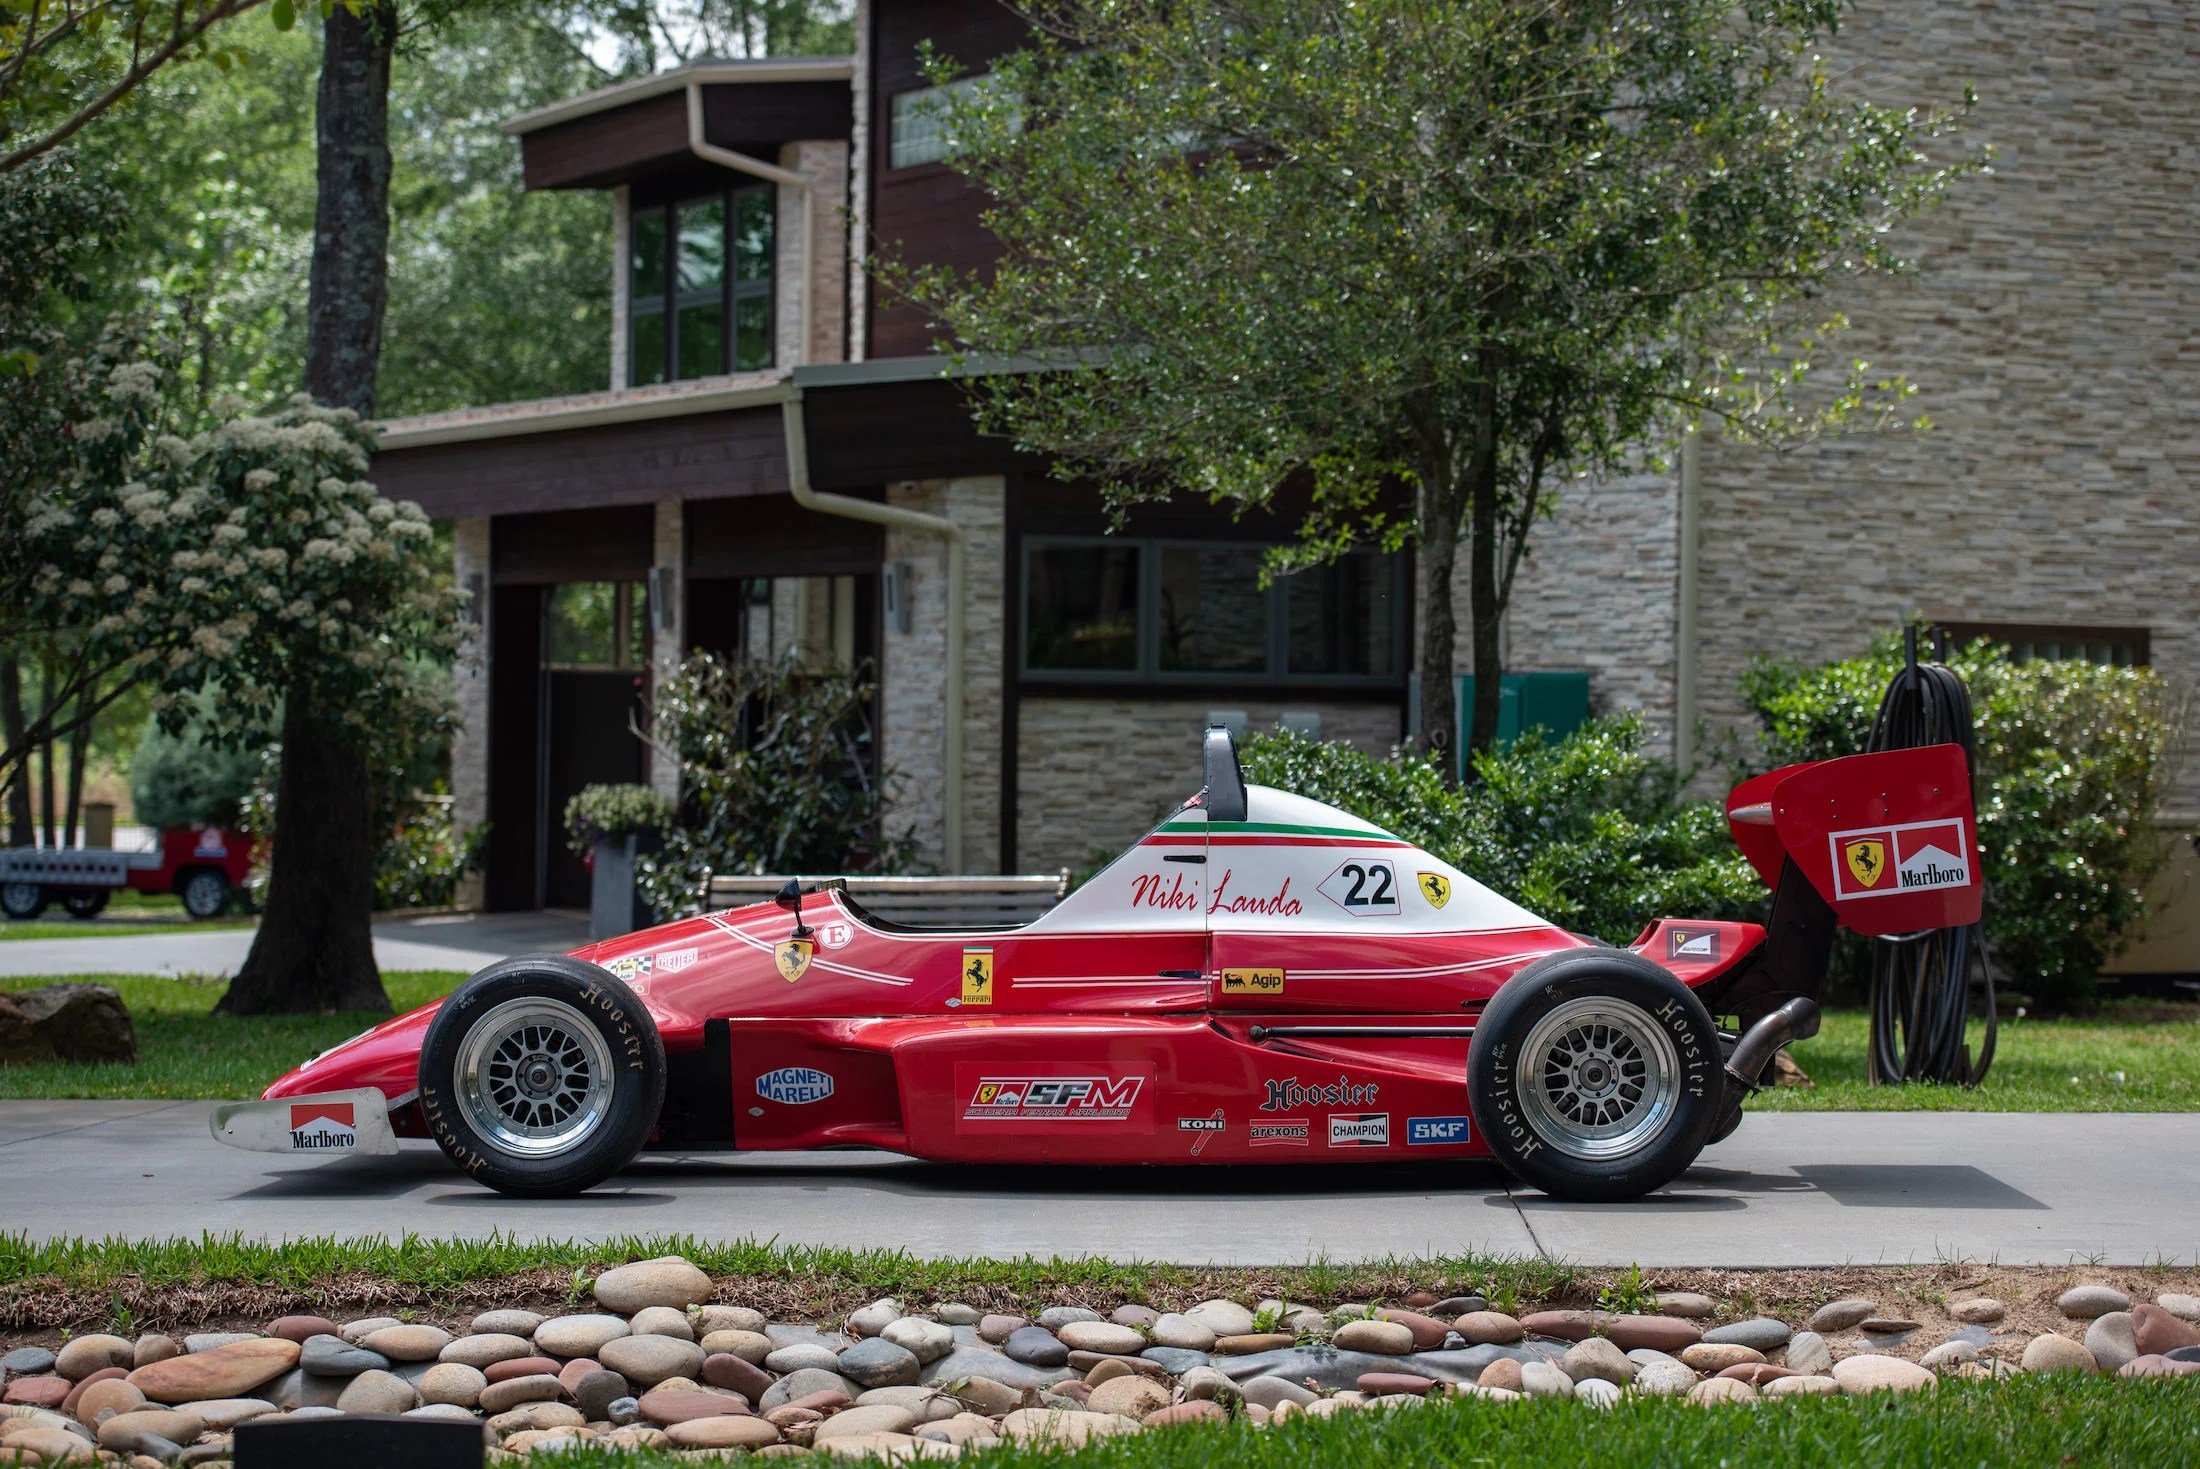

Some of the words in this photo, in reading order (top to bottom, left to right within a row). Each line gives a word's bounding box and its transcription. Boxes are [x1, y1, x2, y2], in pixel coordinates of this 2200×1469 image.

[1341, 863, 1396, 907] 22
[1901, 863, 1964, 887] Marlboro
[1131, 872, 1199, 910] Niki
[1207, 868, 1303, 916] Lauda
[827, 925, 846, 945] E
[660, 953, 695, 968] HEUER
[1250, 972, 1282, 989] Agip
[963, 994, 991, 1003] Ferrari
[1654, 998, 1711, 1097] Hoosier
[758, 1069, 832, 1097] MAGNETI
[758, 1075, 832, 1103] MARELLI
[1023, 1077, 1144, 1107] SFM
[1259, 1075, 1380, 1111] Hoosier
[965, 1108, 1018, 1116] SCUDERIA
[1020, 1108, 1066, 1116] FERRARI
[1069, 1108, 1131, 1116] MARLBORO
[1488, 1060, 1543, 1160] Hoosier
[1180, 1120, 1223, 1129] KONI
[1250, 1126, 1308, 1138] arexons
[1332, 1124, 1386, 1137] CHAMPION
[1414, 1122, 1464, 1139] SKF
[292, 1130, 355, 1149] Marlboro
